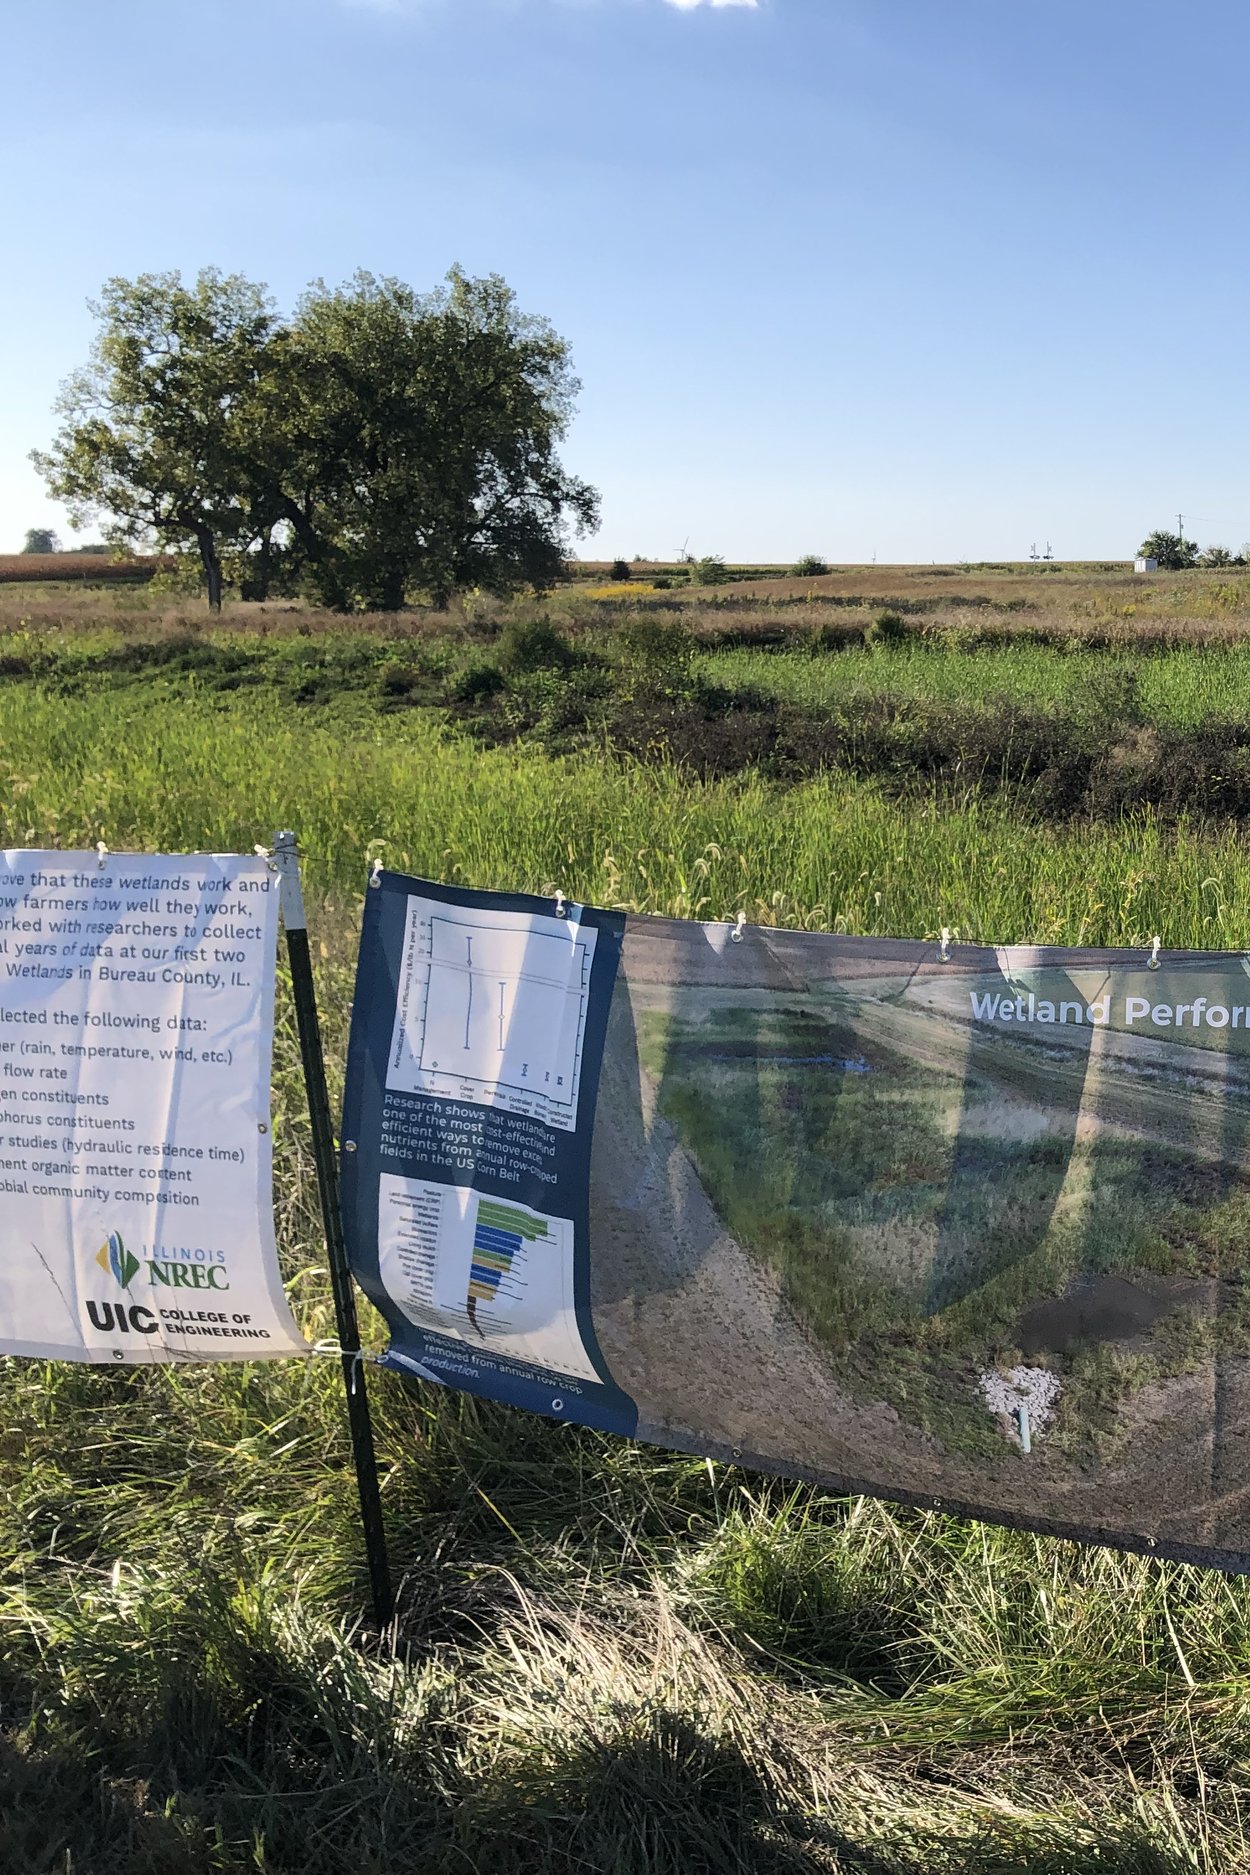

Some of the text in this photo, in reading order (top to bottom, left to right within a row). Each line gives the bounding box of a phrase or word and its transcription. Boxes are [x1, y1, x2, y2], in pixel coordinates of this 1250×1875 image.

[31, 872, 269, 892] that these wetlands work and
[24, 894, 88, 911] farmers
[127, 898, 160, 912] well
[205, 901, 252, 918] work,
[49, 919, 81, 933] with
[203, 924, 261, 939] collect
[6, 963, 250, 988] Wetlands in Bureau County, IL.
[970, 989, 1110, 1025] Wetland
[53, 1011, 79, 1025] the
[84, 1012, 160, 1033] following
[167, 1015, 206, 1031] data:
[20, 1041, 55, 1055] (rain,
[61, 1044, 154, 1061] temperature,
[202, 1050, 232, 1066] etc.)
[4, 1063, 67, 1079] flow rate
[22, 1091, 109, 1105] constituents
[385, 1094, 485, 1119] Research shows
[47, 1115, 135, 1130] constituents
[383, 1109, 482, 1131] one of the most
[382, 1120, 432, 1137] efficient
[437, 1130, 468, 1143] ways
[472, 1135, 484, 1145] to
[9, 1136, 57, 1149] studies
[209, 1146, 244, 1164] time)
[381, 1133, 437, 1150] nutrients
[441, 1142, 471, 1156] from
[32, 1161, 79, 1176] organic
[86, 1165, 134, 1177] matter
[380, 1144, 412, 1158] fields
[417, 1151, 427, 1162] in
[432, 1152, 452, 1166] the
[457, 1155, 474, 1169] US
[500, 1168, 520, 1182] Belt
[33, 1186, 109, 1203] community
[143, 1243, 225, 1265] ILLINOIS
[145, 1260, 229, 1290] NREC
[86, 1301, 159, 1333] UIC
[160, 1309, 251, 1324] COLLEGE OF
[165, 1324, 270, 1338] ENGINEERING
[472, 1356, 496, 1370] from
